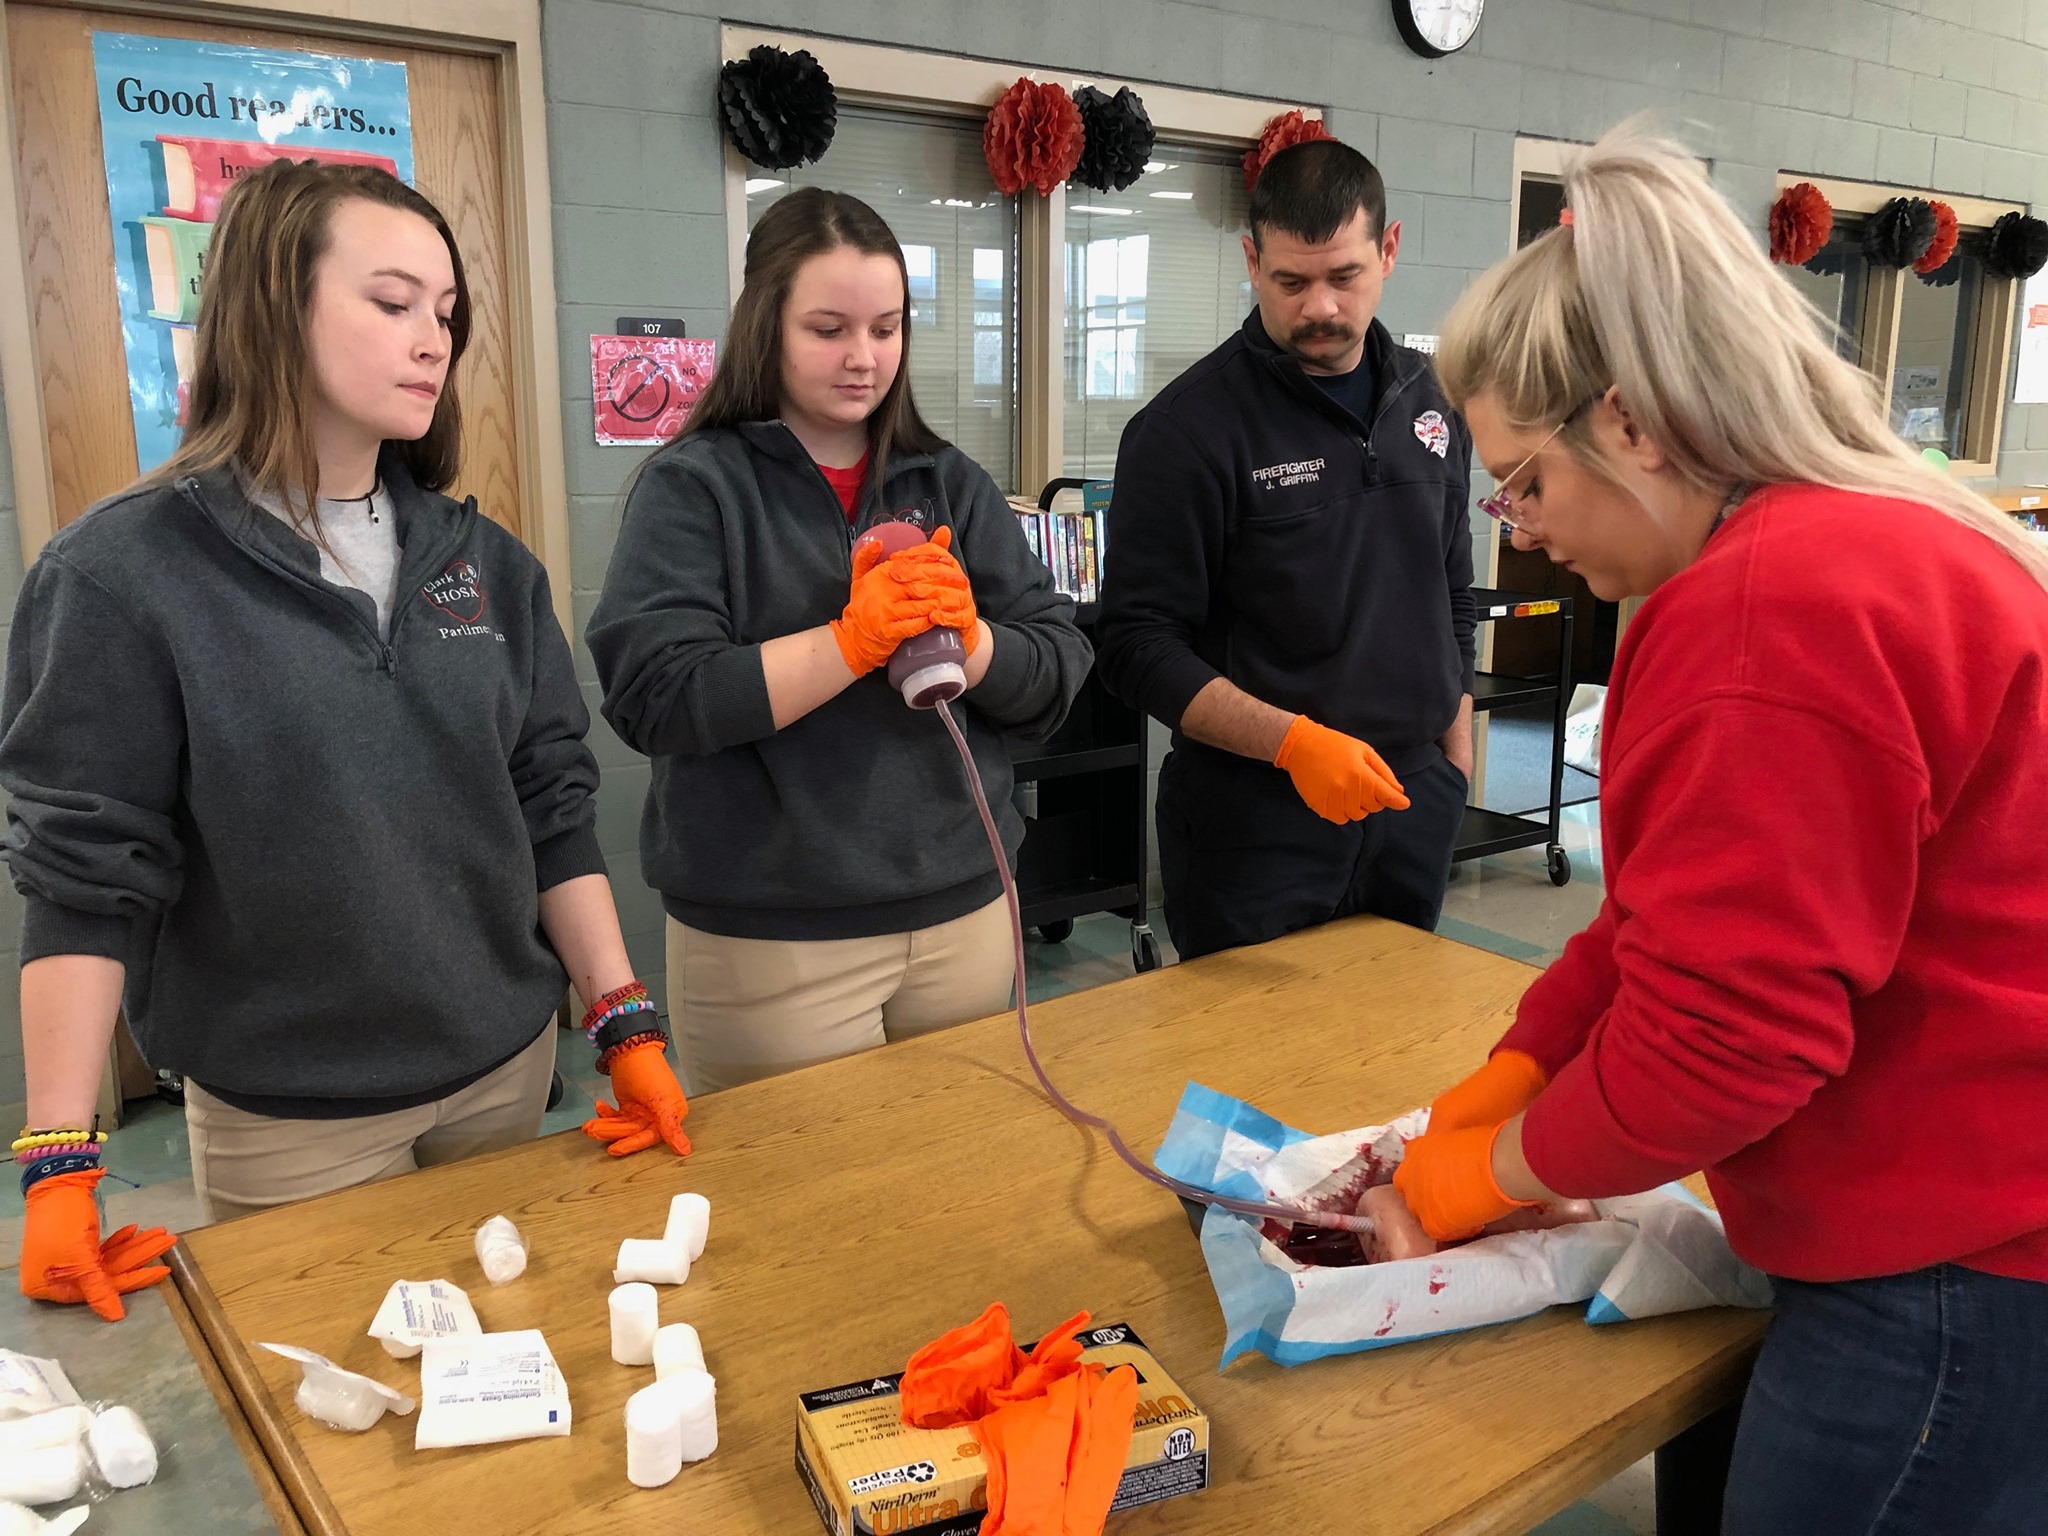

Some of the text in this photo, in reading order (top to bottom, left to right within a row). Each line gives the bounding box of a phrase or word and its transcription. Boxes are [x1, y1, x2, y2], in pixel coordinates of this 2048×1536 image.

[116, 77, 220, 119] Good
[643, 324, 662, 334] 107
[682, 368, 696, 376] NO
[1252, 458, 1325, 482] FIREFIGHTER
[1266, 472, 1320, 490] J. GRIFFITH
[424, 572, 454, 594] Clark
[434, 586, 480, 604] HOSA
[1170, 1432, 1192, 1444] NON
[1168, 1440, 1192, 1458] LATEX
[852, 1468, 905, 1487] Paper
[853, 1477, 907, 1494] Recycled
[873, 1498, 960, 1536] Ultra
